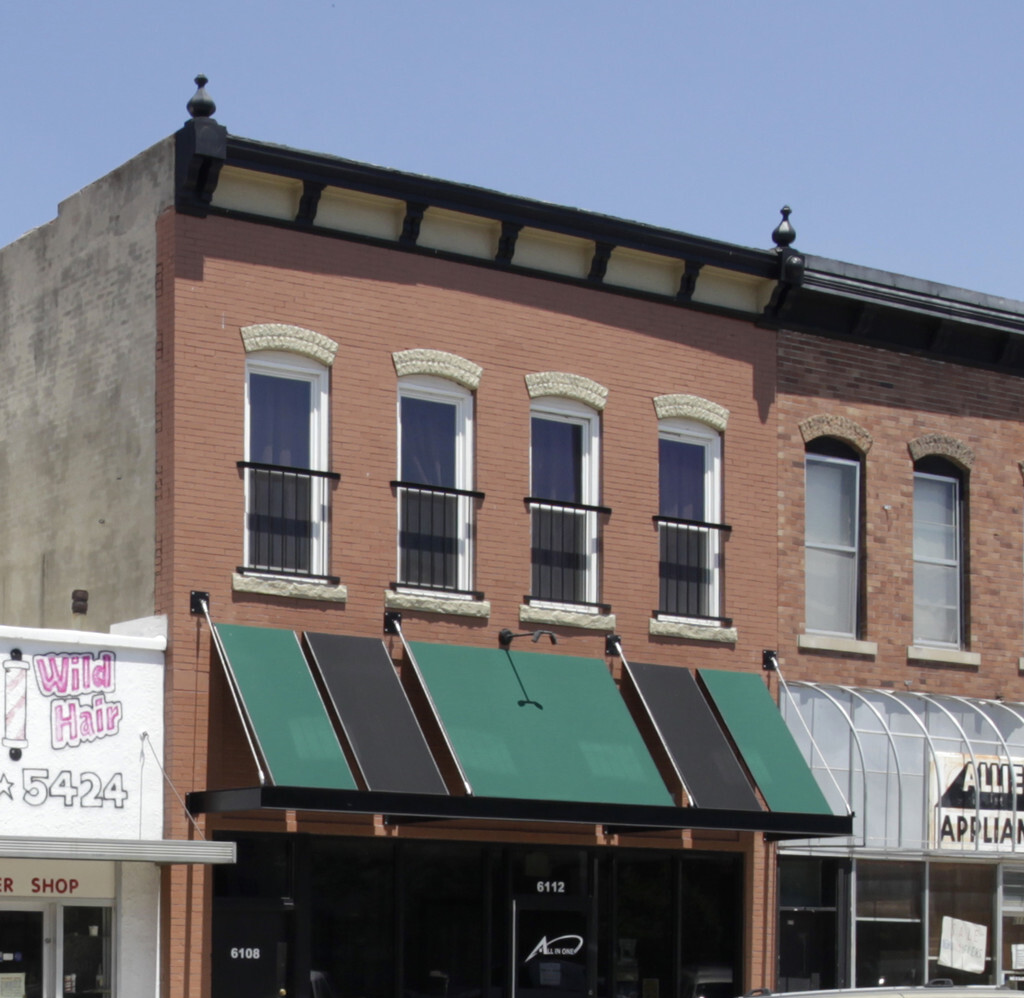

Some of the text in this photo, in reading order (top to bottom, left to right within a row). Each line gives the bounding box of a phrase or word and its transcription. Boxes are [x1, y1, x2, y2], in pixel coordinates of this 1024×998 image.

[34, 651, 115, 696] Wild
[52, 698, 121, 748] Hair
[30, 877, 80, 894] SHOP
[536, 881, 566, 893] 6112
[230, 946, 261, 960] 6108
